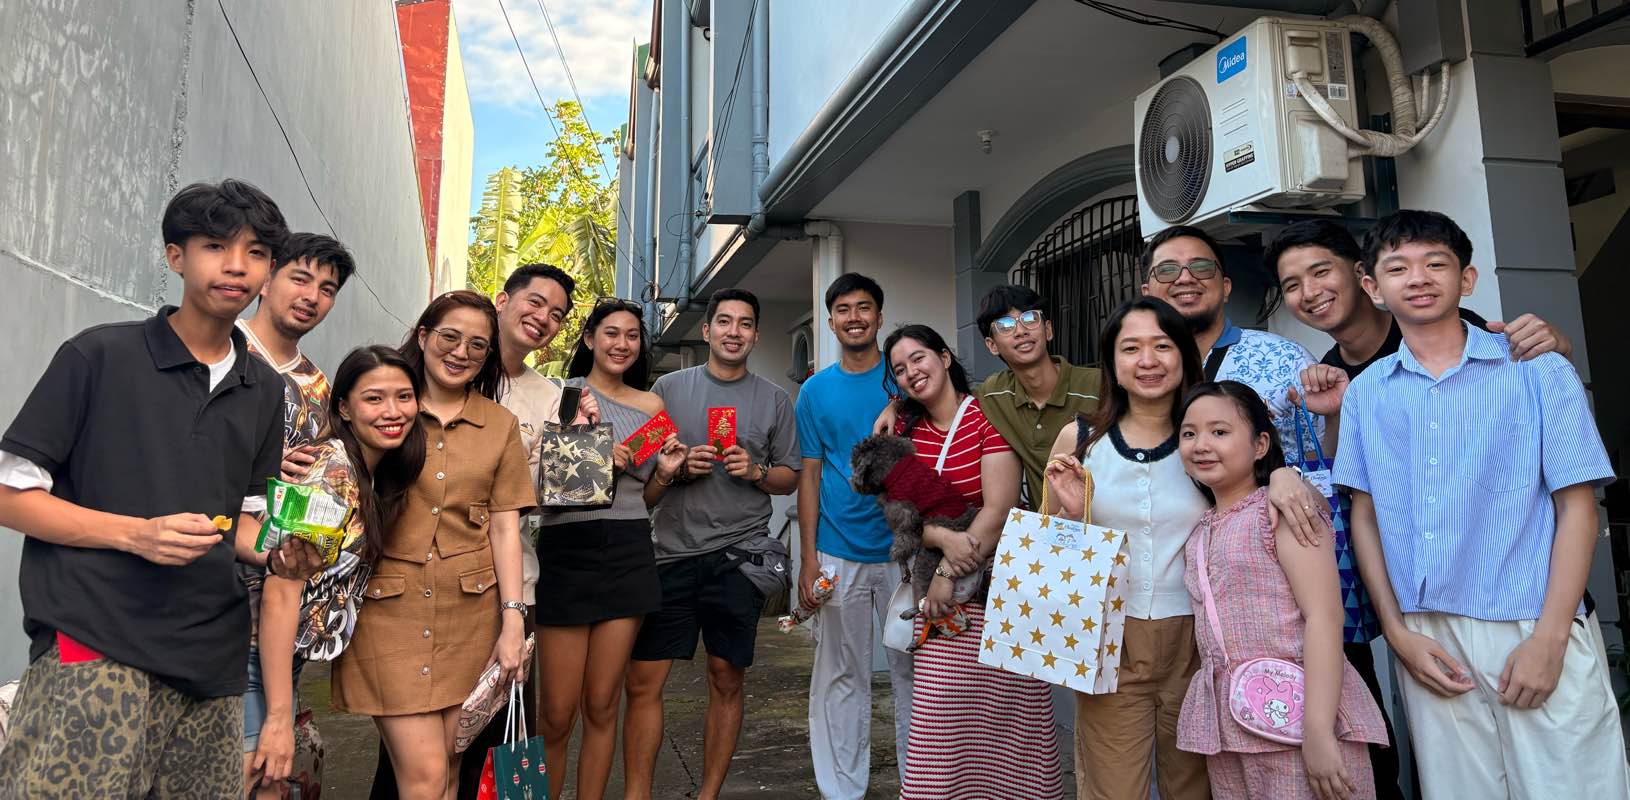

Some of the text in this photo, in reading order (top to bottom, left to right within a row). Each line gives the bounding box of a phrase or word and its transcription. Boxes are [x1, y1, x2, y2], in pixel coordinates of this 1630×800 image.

[1219, 52, 1245, 73] Midea
[1264, 668, 1296, 681] My Melody
